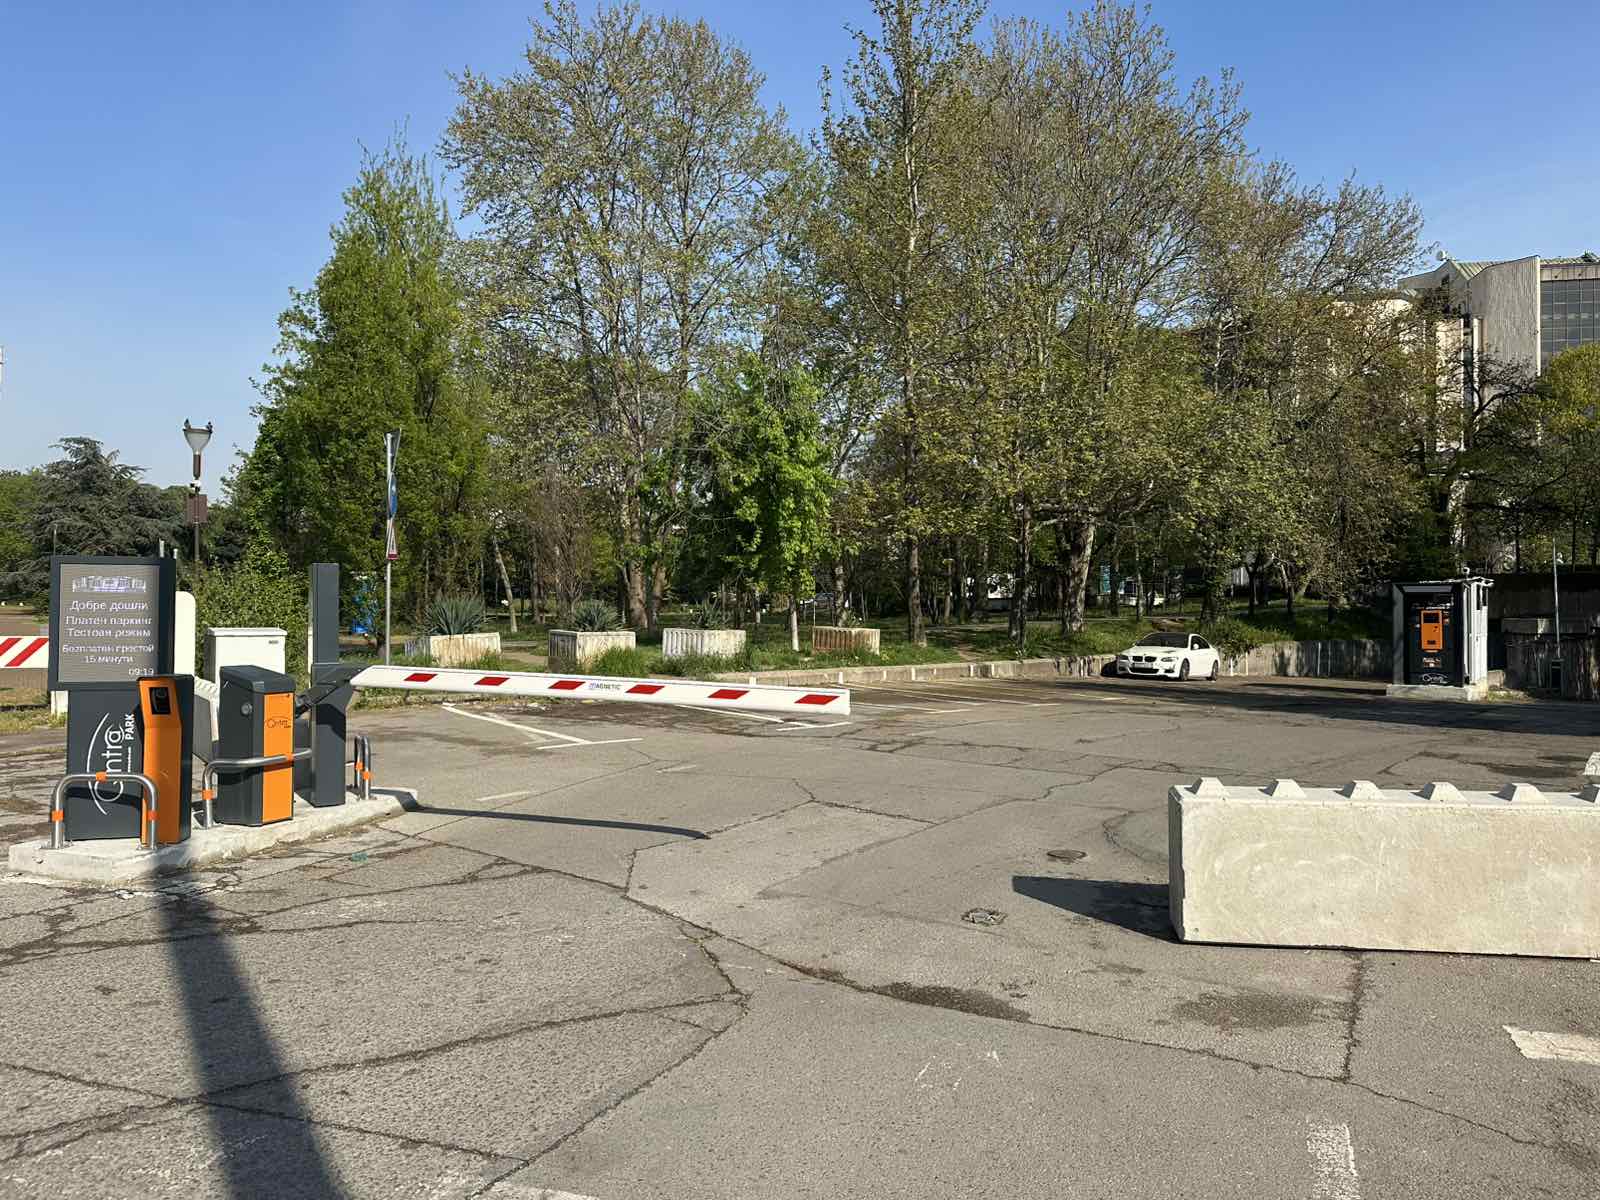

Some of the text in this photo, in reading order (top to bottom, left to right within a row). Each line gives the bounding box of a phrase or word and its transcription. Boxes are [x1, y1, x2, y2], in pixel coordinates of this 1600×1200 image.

[71, 600, 148, 612] Добре дошли
[66, 615, 152, 627] Платен паркинг
[114, 628, 151, 638] режим
[125, 713, 135, 740] PARK
